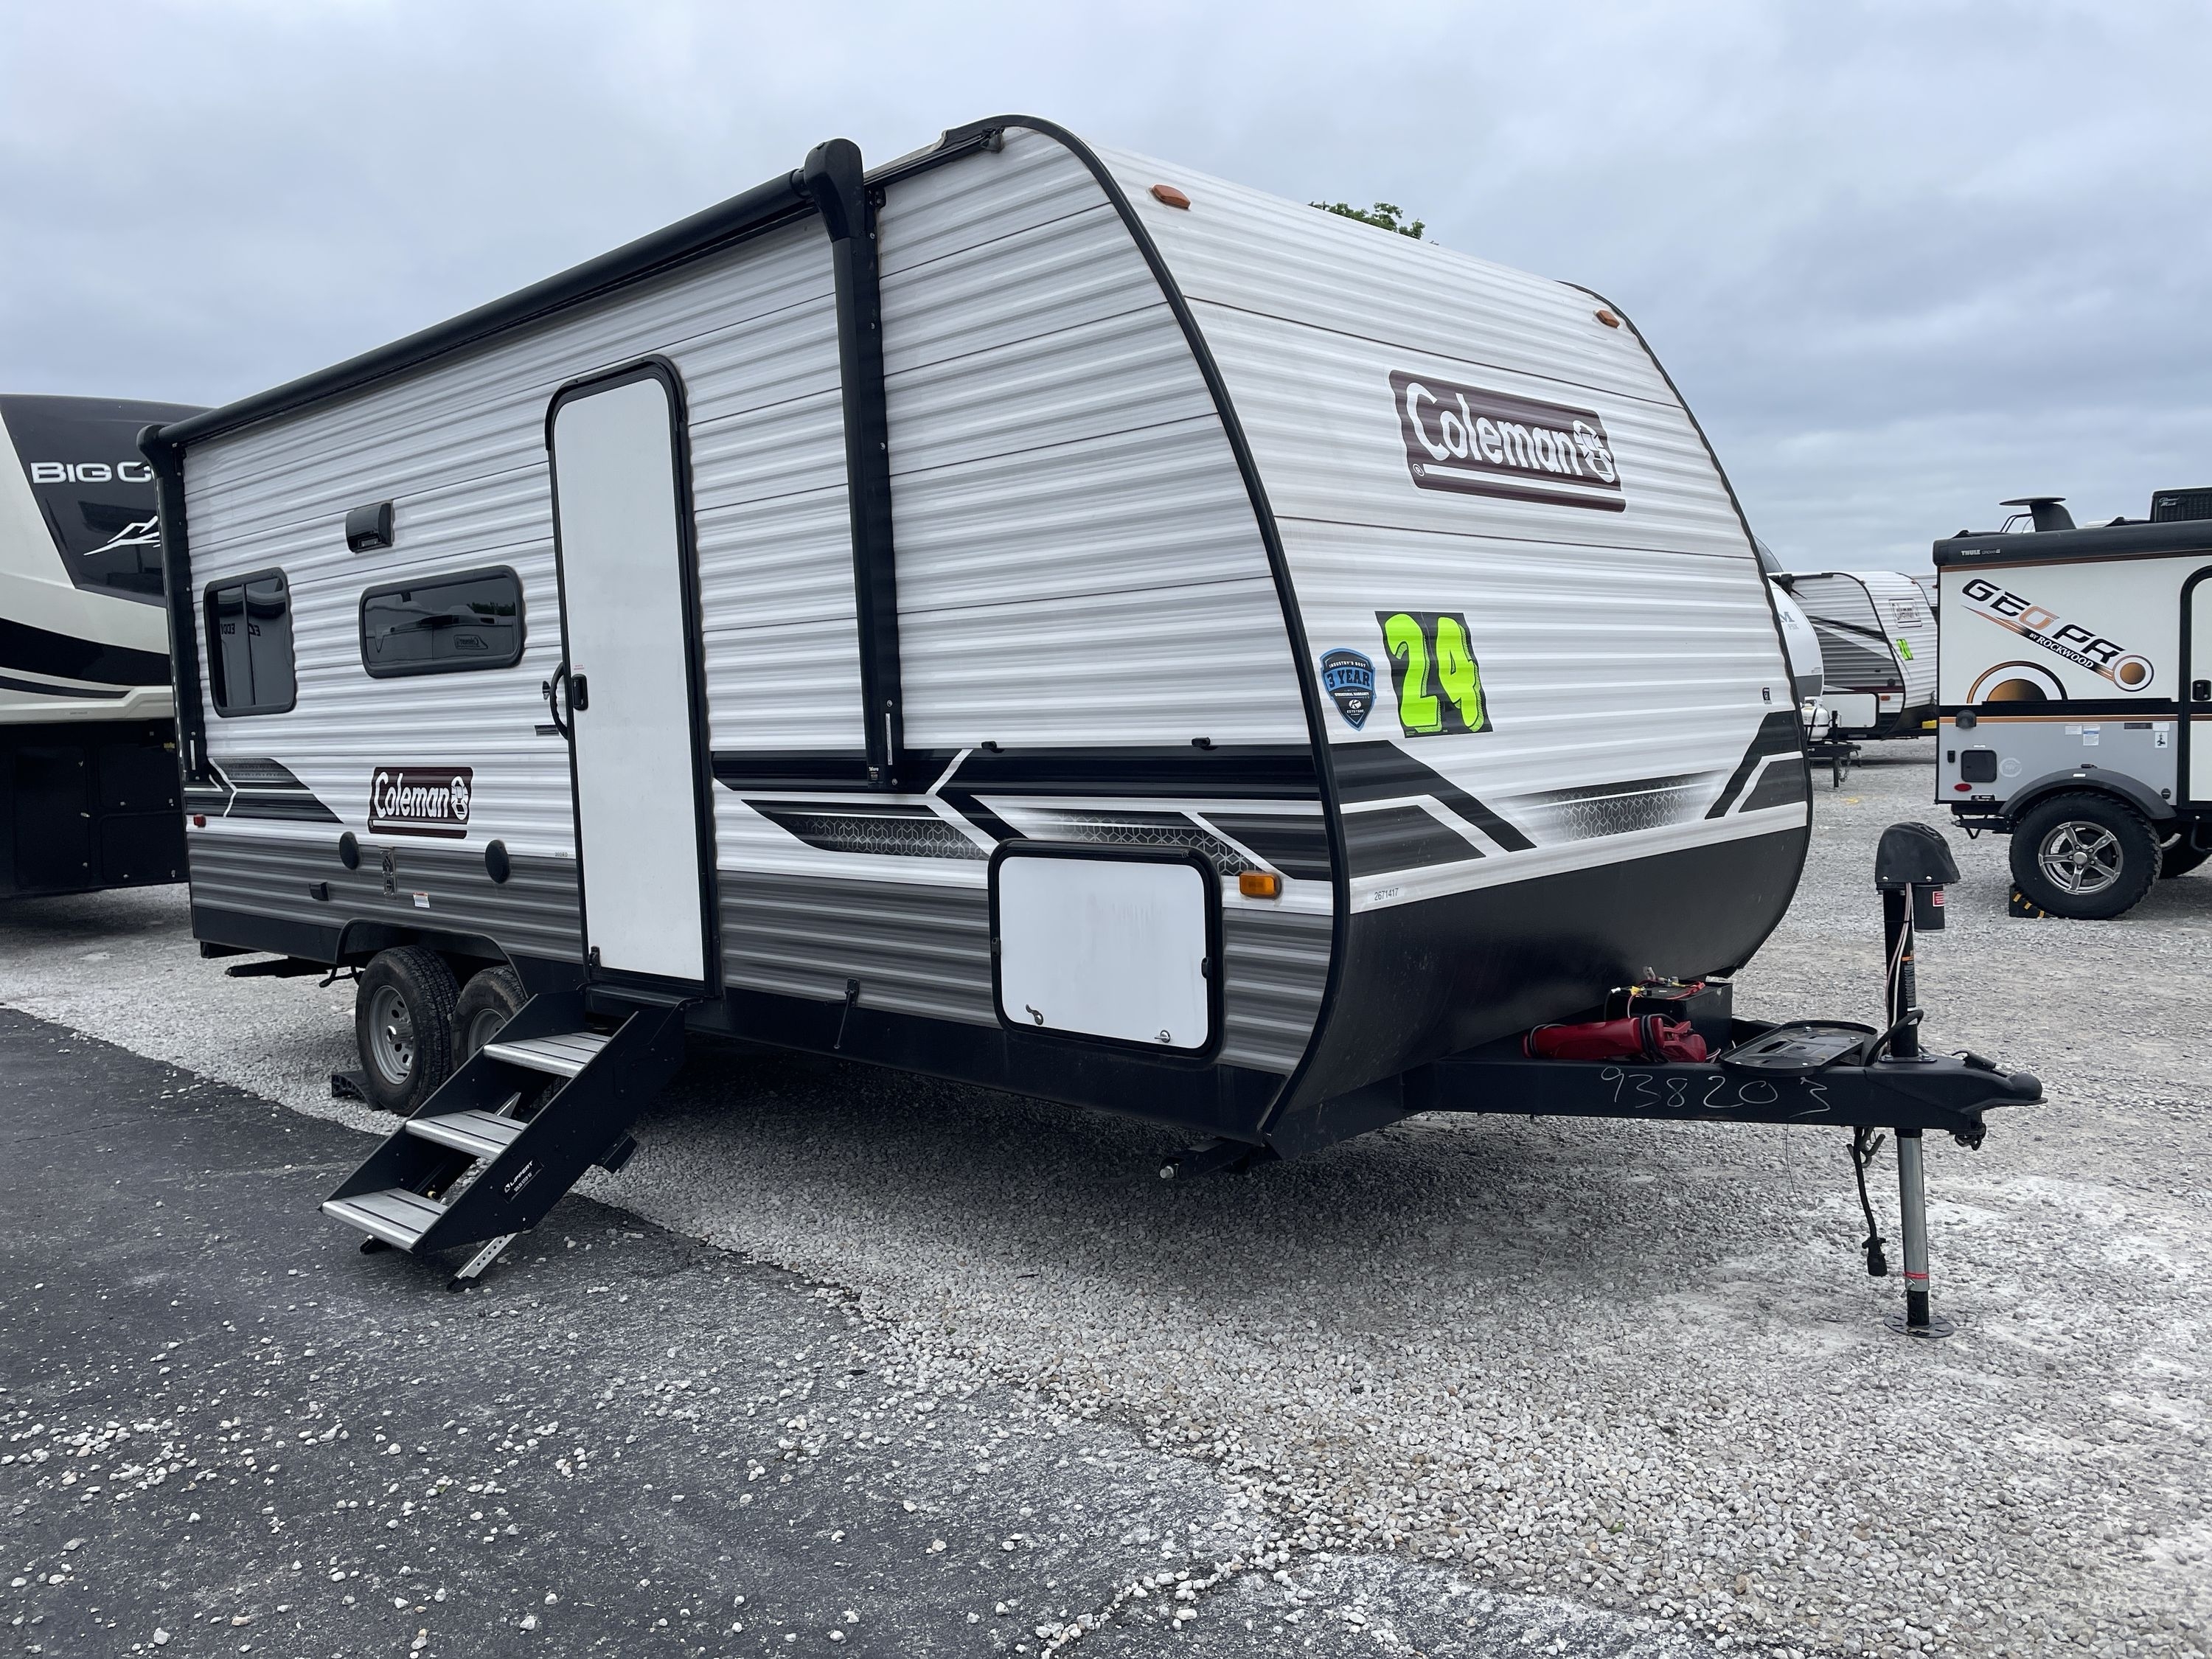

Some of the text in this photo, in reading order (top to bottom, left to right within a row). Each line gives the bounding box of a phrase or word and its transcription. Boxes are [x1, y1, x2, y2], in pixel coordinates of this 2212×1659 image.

[1406, 382, 1584, 476] Coleman
[30, 462, 112, 484] BIG
[1961, 578, 2060, 630] GEO
[2037, 636, 2094, 668] ROCKWOOD
[1326, 669, 1370, 688] 3 YEAR
[1384, 613, 1485, 733] 24
[374, 771, 450, 818] Coleman
[1374, 887, 1399, 901] 2671417
[1601, 1066, 1831, 1119] 938203
[509, 1160, 533, 1186] LIPPERT
